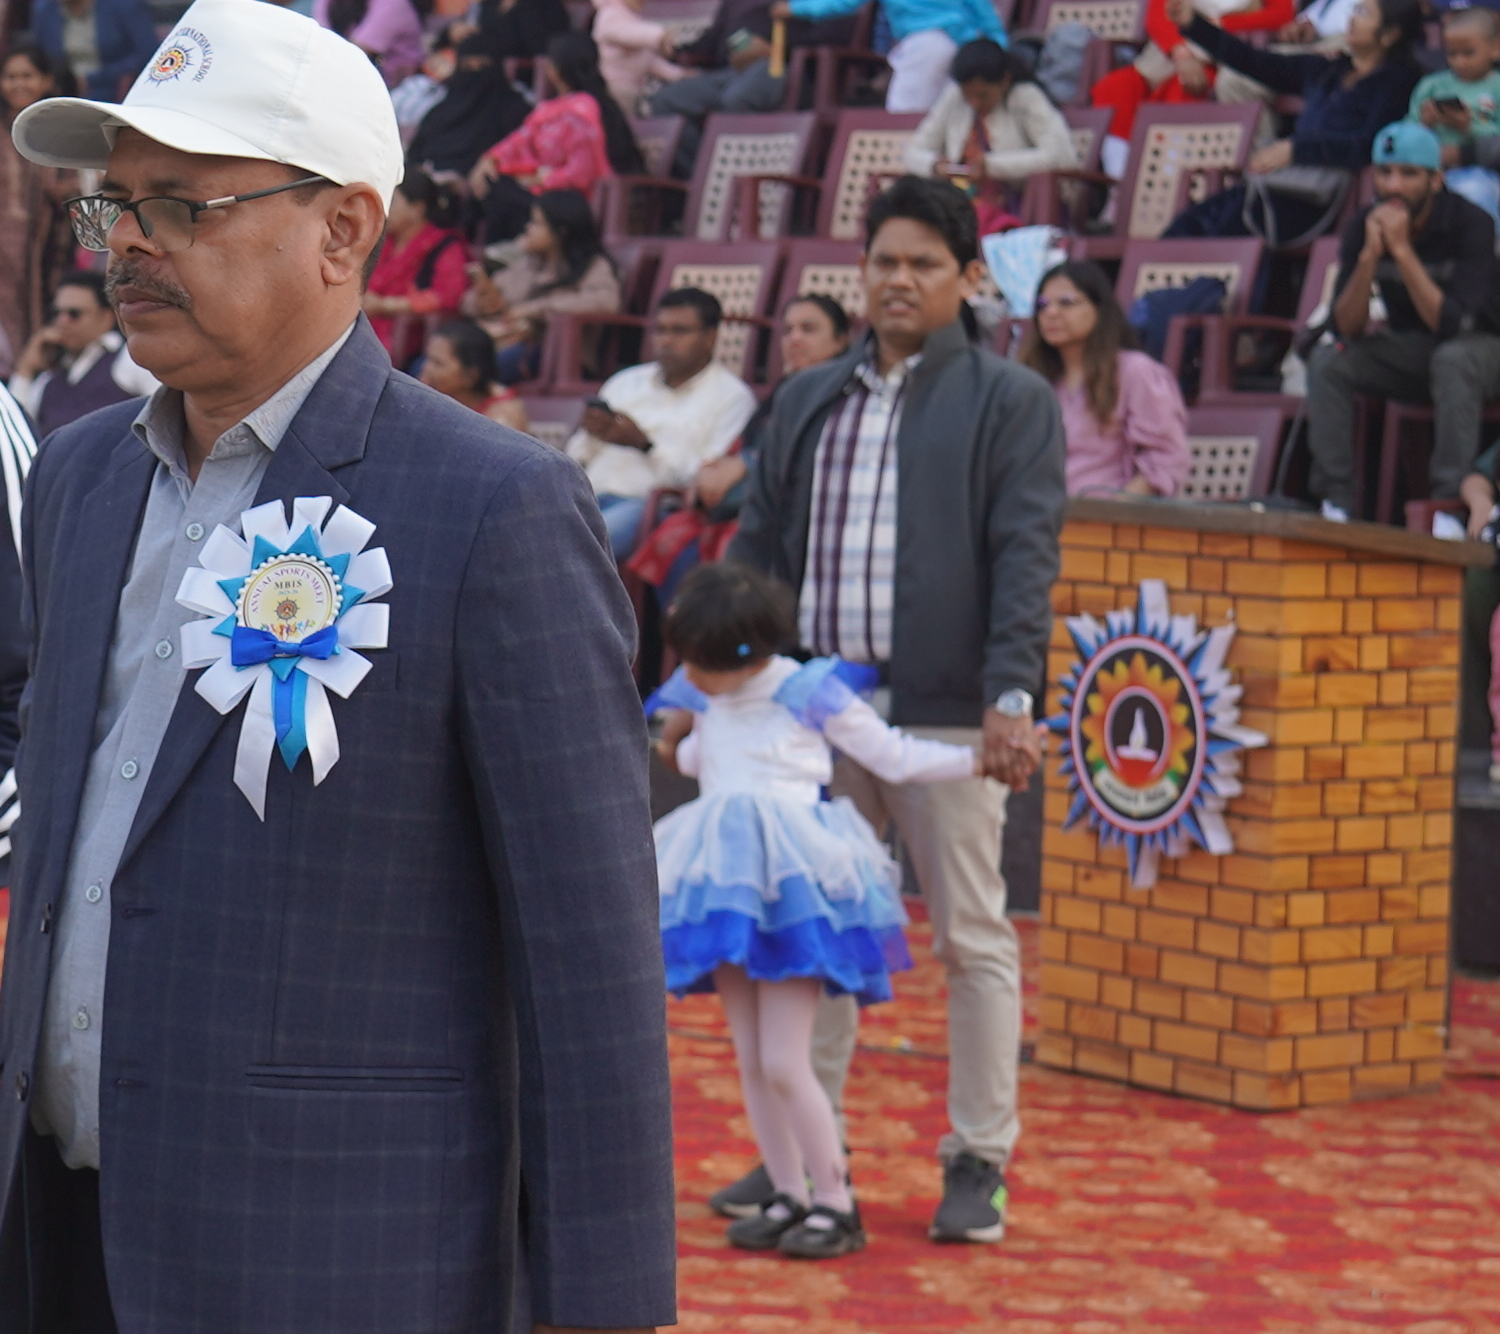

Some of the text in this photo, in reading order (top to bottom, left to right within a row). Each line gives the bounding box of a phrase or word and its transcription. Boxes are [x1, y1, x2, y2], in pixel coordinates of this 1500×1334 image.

[252, 567, 323, 612] ANNUAL SPORTS MEET
[274, 580, 302, 589] MBIS
